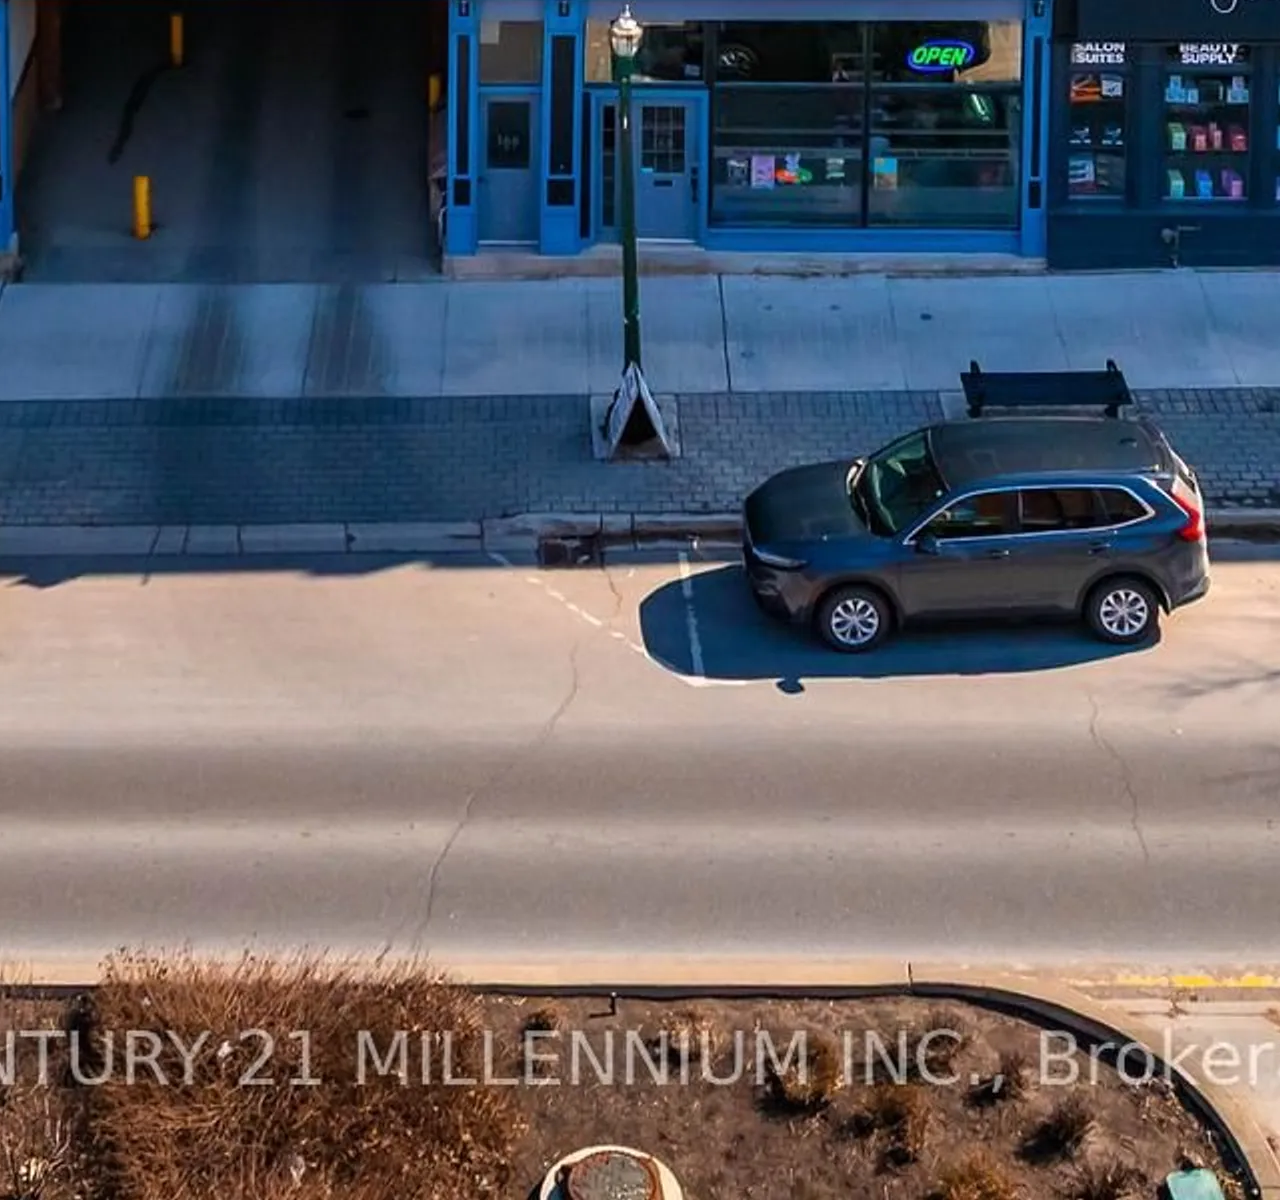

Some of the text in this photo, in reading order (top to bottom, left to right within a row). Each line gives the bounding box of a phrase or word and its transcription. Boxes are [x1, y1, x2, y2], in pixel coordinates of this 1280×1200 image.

[1072, 42, 1126, 53] SALON
[913, 45, 967, 66] OPEN
[1075, 52, 1125, 64] SUITES
[1181, 53, 1237, 65] SUPPLY
